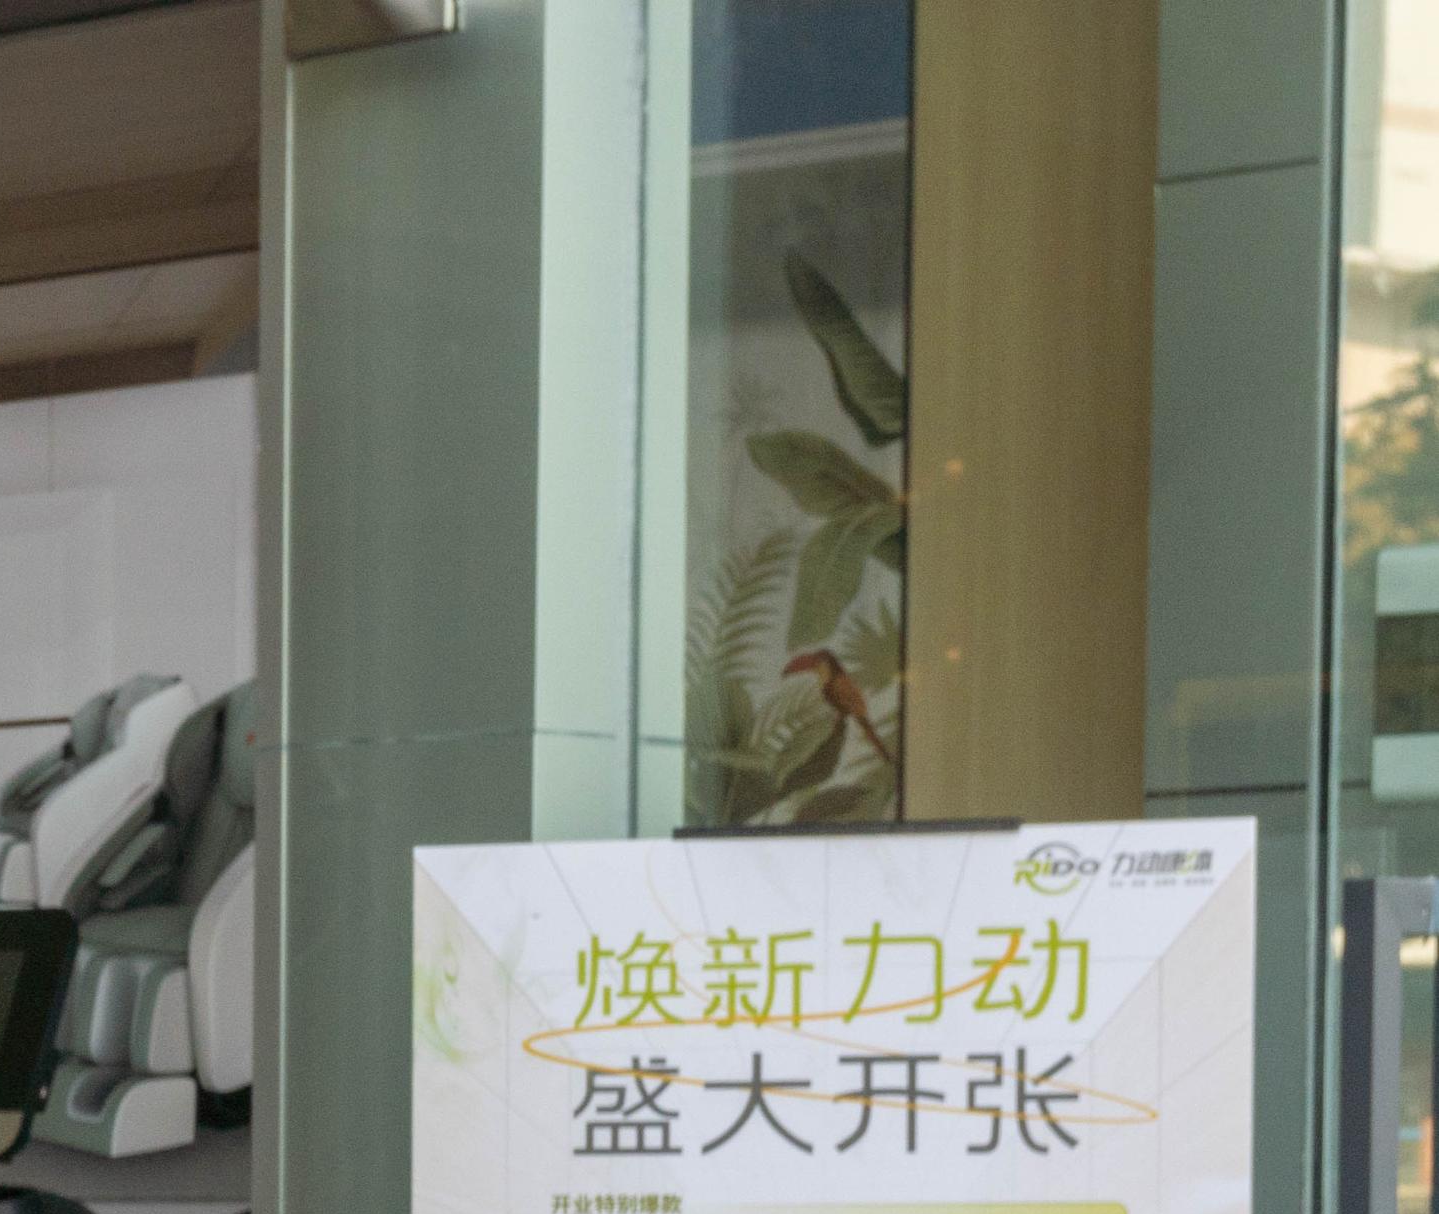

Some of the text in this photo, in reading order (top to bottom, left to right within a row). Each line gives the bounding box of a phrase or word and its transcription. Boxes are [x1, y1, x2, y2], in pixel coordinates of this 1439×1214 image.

[573, 918, 1092, 1029] 焕新力动
[573, 1047, 1080, 1156] 盛大开张
